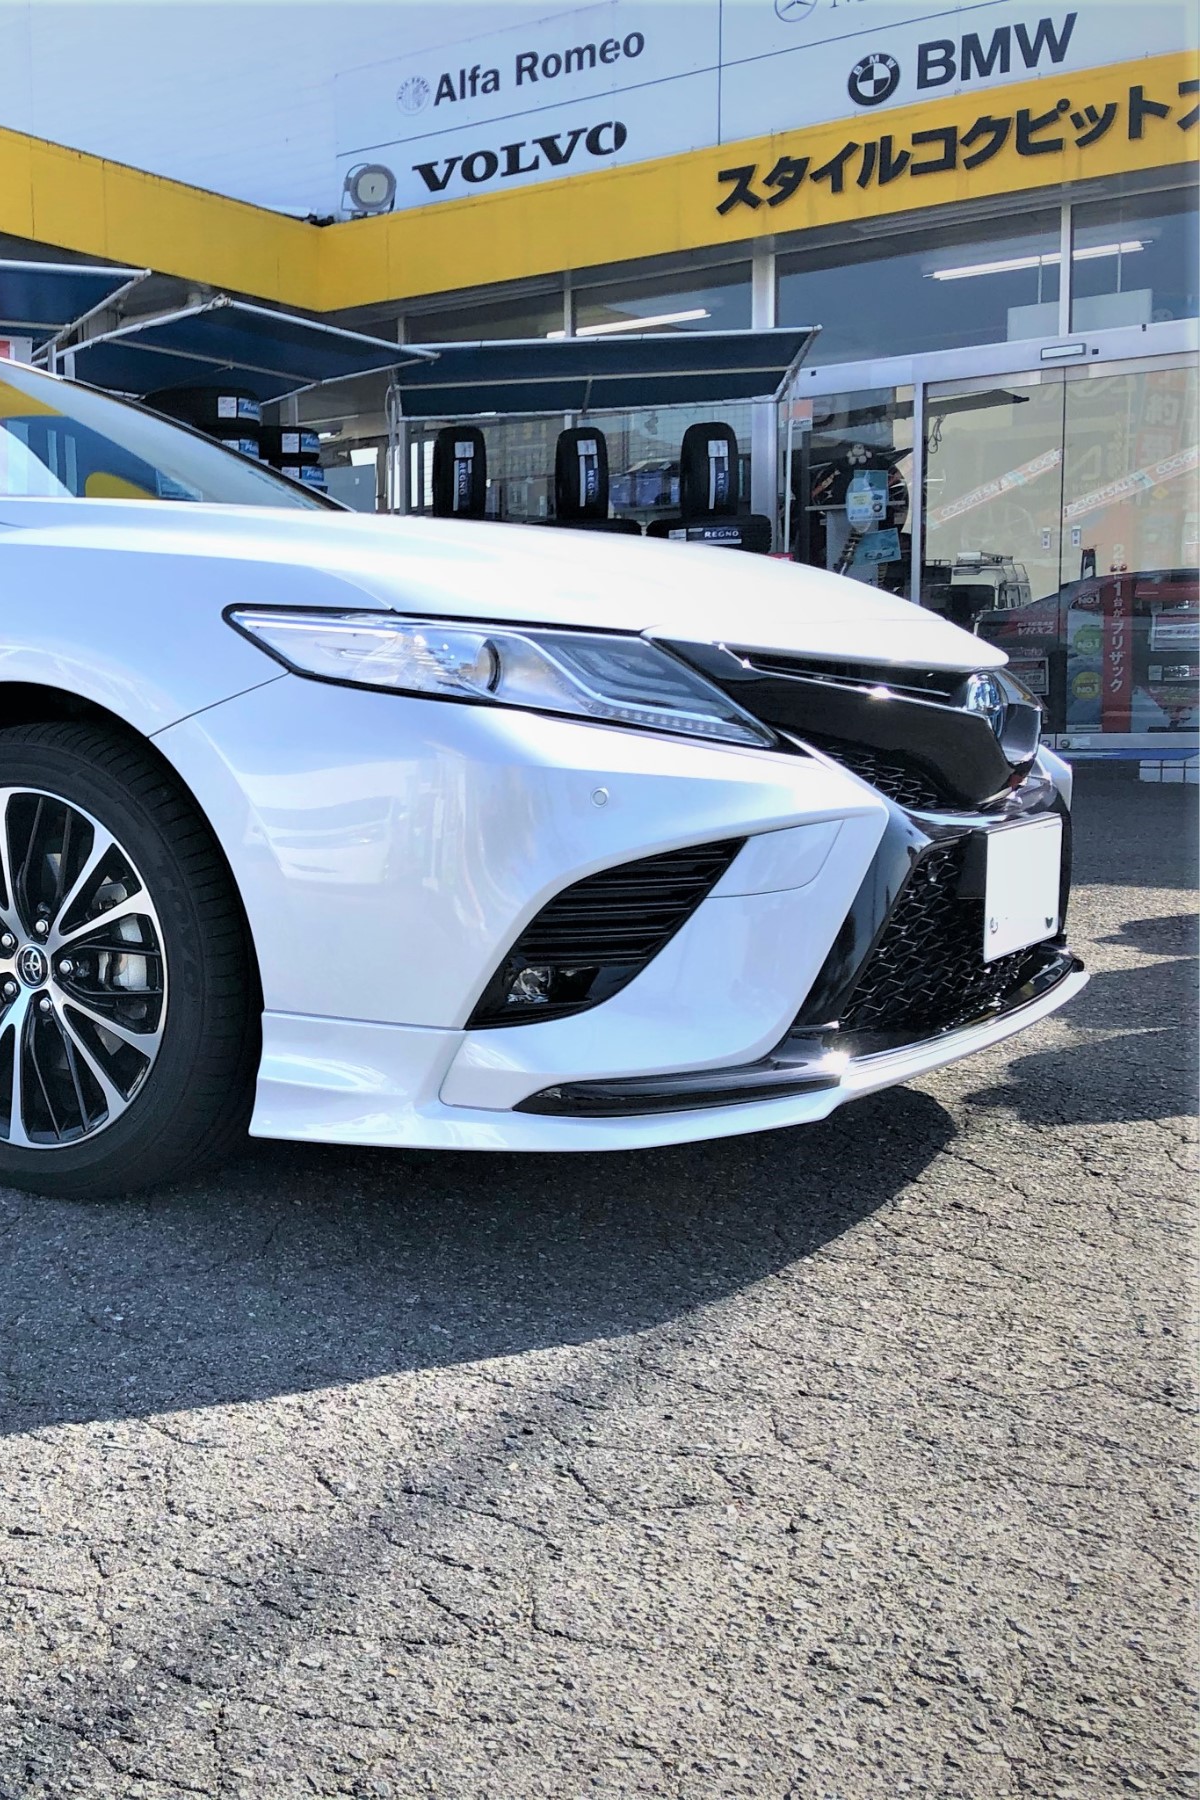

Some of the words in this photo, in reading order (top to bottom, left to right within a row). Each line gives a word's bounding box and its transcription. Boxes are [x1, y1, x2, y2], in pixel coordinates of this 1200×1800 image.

[433, 64, 500, 107] Alfa
[515, 32, 645, 86] Romeo
[916, 12, 1078, 90] BMW
[411, 121, 627, 192] VOLVO
[704, 530, 739, 539] REGNO
